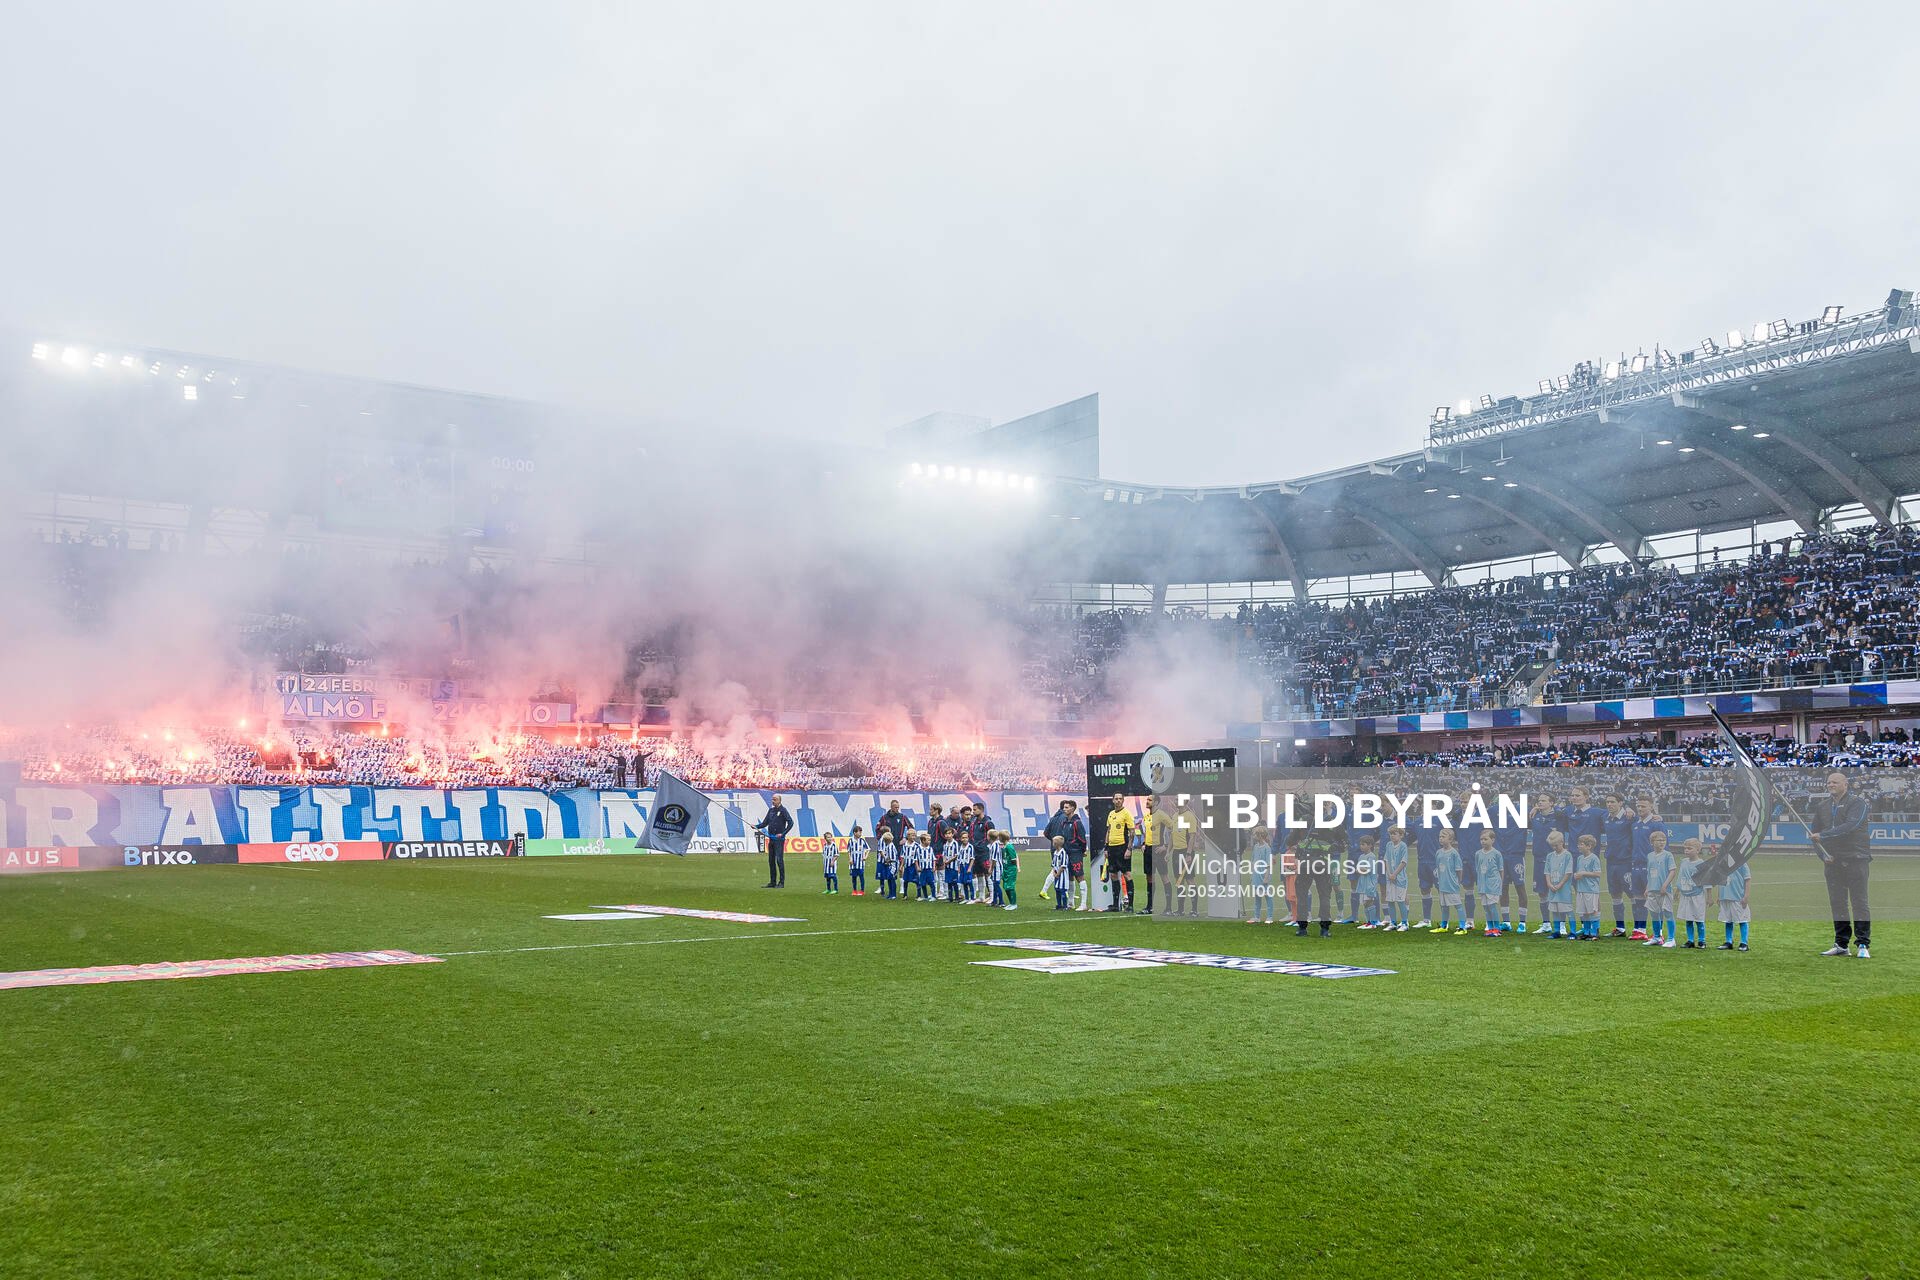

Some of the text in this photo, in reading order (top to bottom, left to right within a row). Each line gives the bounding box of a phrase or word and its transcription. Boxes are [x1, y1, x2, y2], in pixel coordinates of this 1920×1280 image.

[1093, 763, 1133, 777] UNIBET
[1183, 758, 1227, 774] UNIBET
[162, 787, 562, 844] ALLTID
[124, 845, 197, 866] Brixo.
[285, 843, 338, 862] GARO
[395, 842, 505, 859] OPTIMERA
